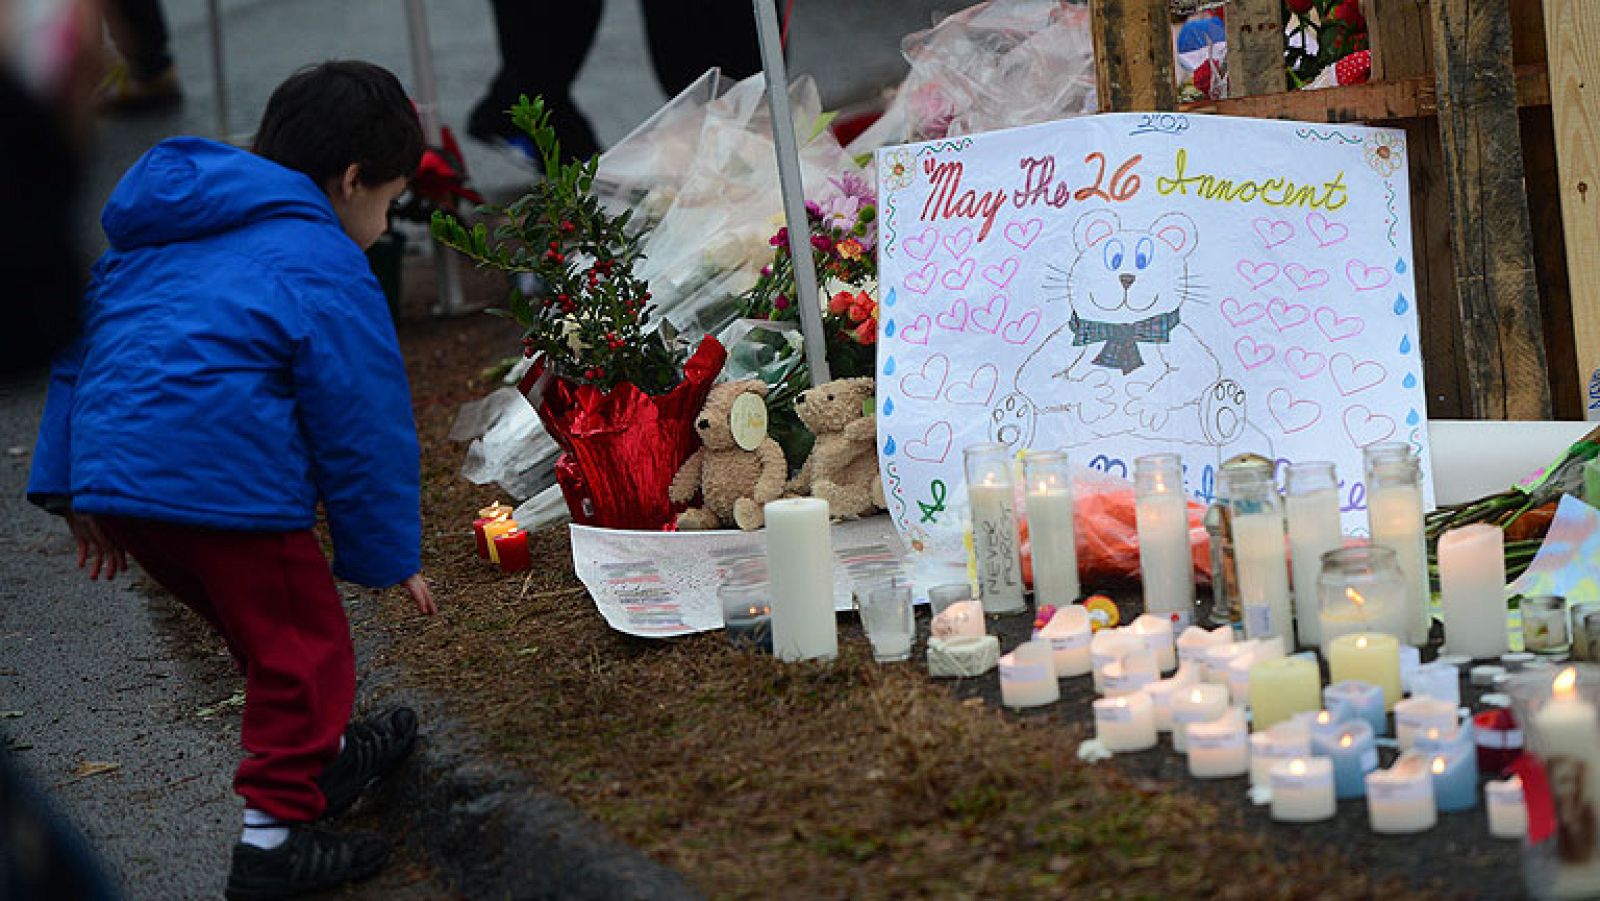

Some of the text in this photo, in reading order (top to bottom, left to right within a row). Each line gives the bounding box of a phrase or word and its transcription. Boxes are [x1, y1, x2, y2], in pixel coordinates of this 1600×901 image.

[1074, 152, 1143, 202] 26
[1156, 148, 1348, 211] Innocent
[982, 520, 1001, 595] NEVER
